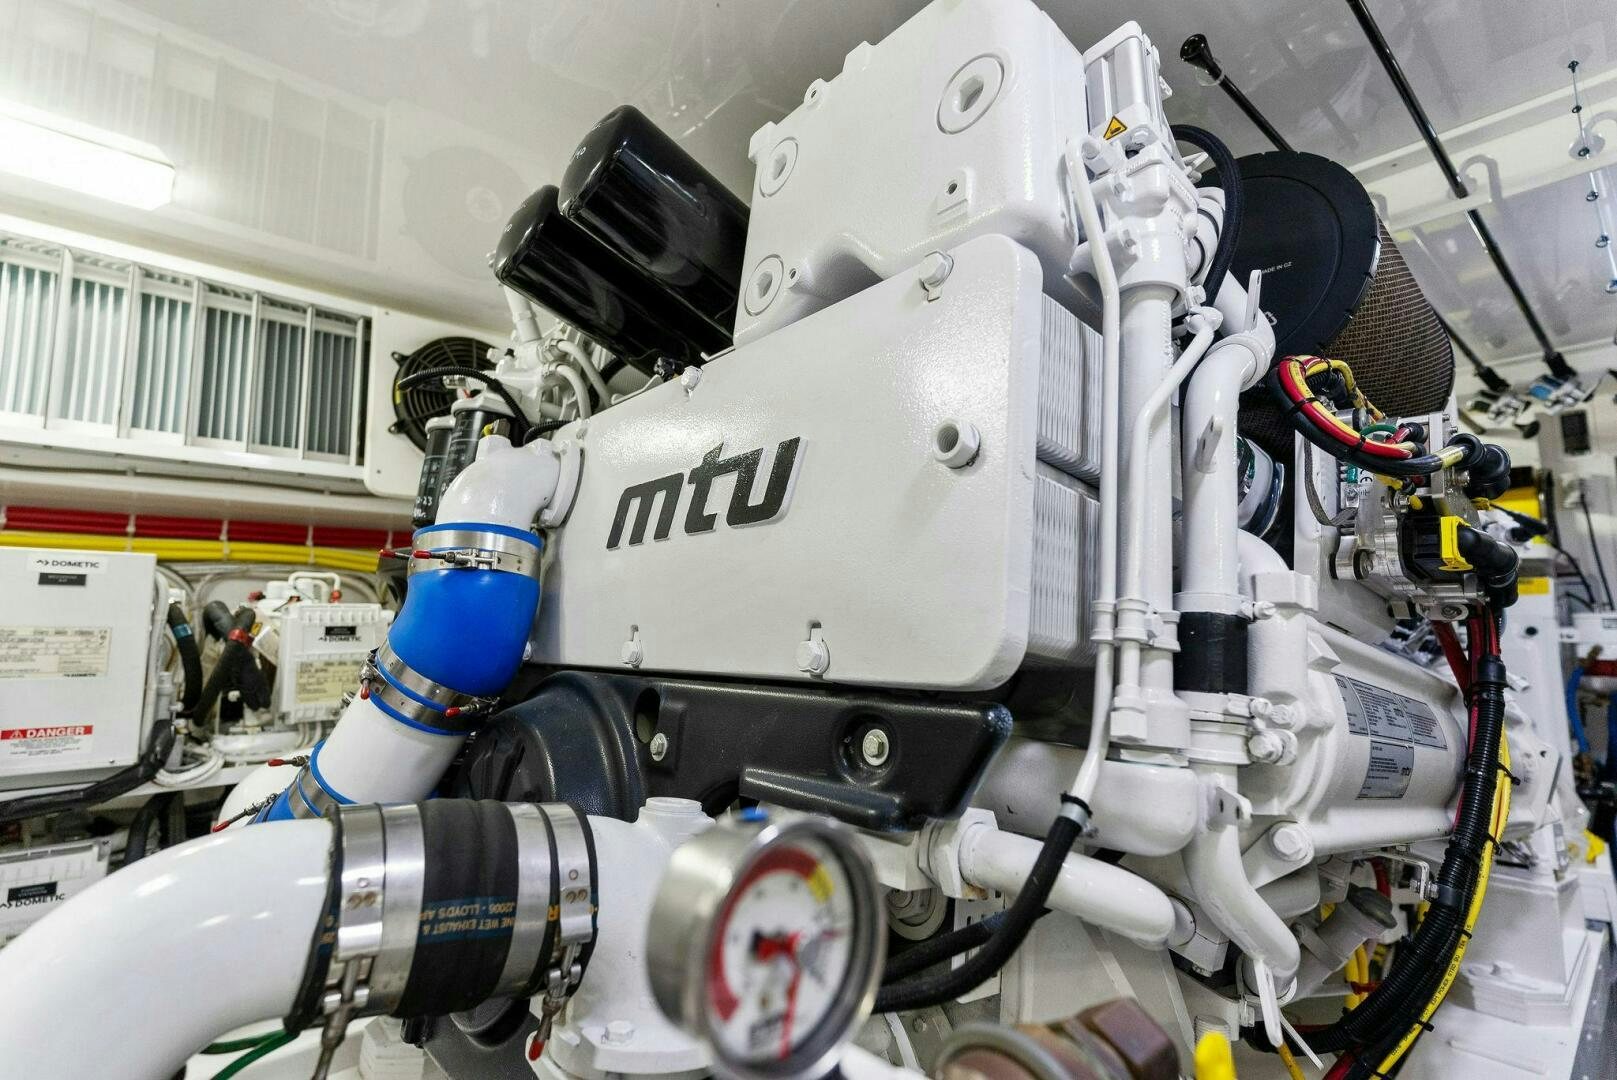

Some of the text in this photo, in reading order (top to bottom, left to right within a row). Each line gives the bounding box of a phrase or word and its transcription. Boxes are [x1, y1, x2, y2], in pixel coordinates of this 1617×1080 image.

[606, 436, 803, 550] mtu
[51, 560, 99, 568] DOMETIC
[26, 726, 85, 738] DANGER
[15, 893, 65, 907] DOMETIC
[432, 919, 477, 936] EXHAUST
[478, 919, 499, 930] WET
